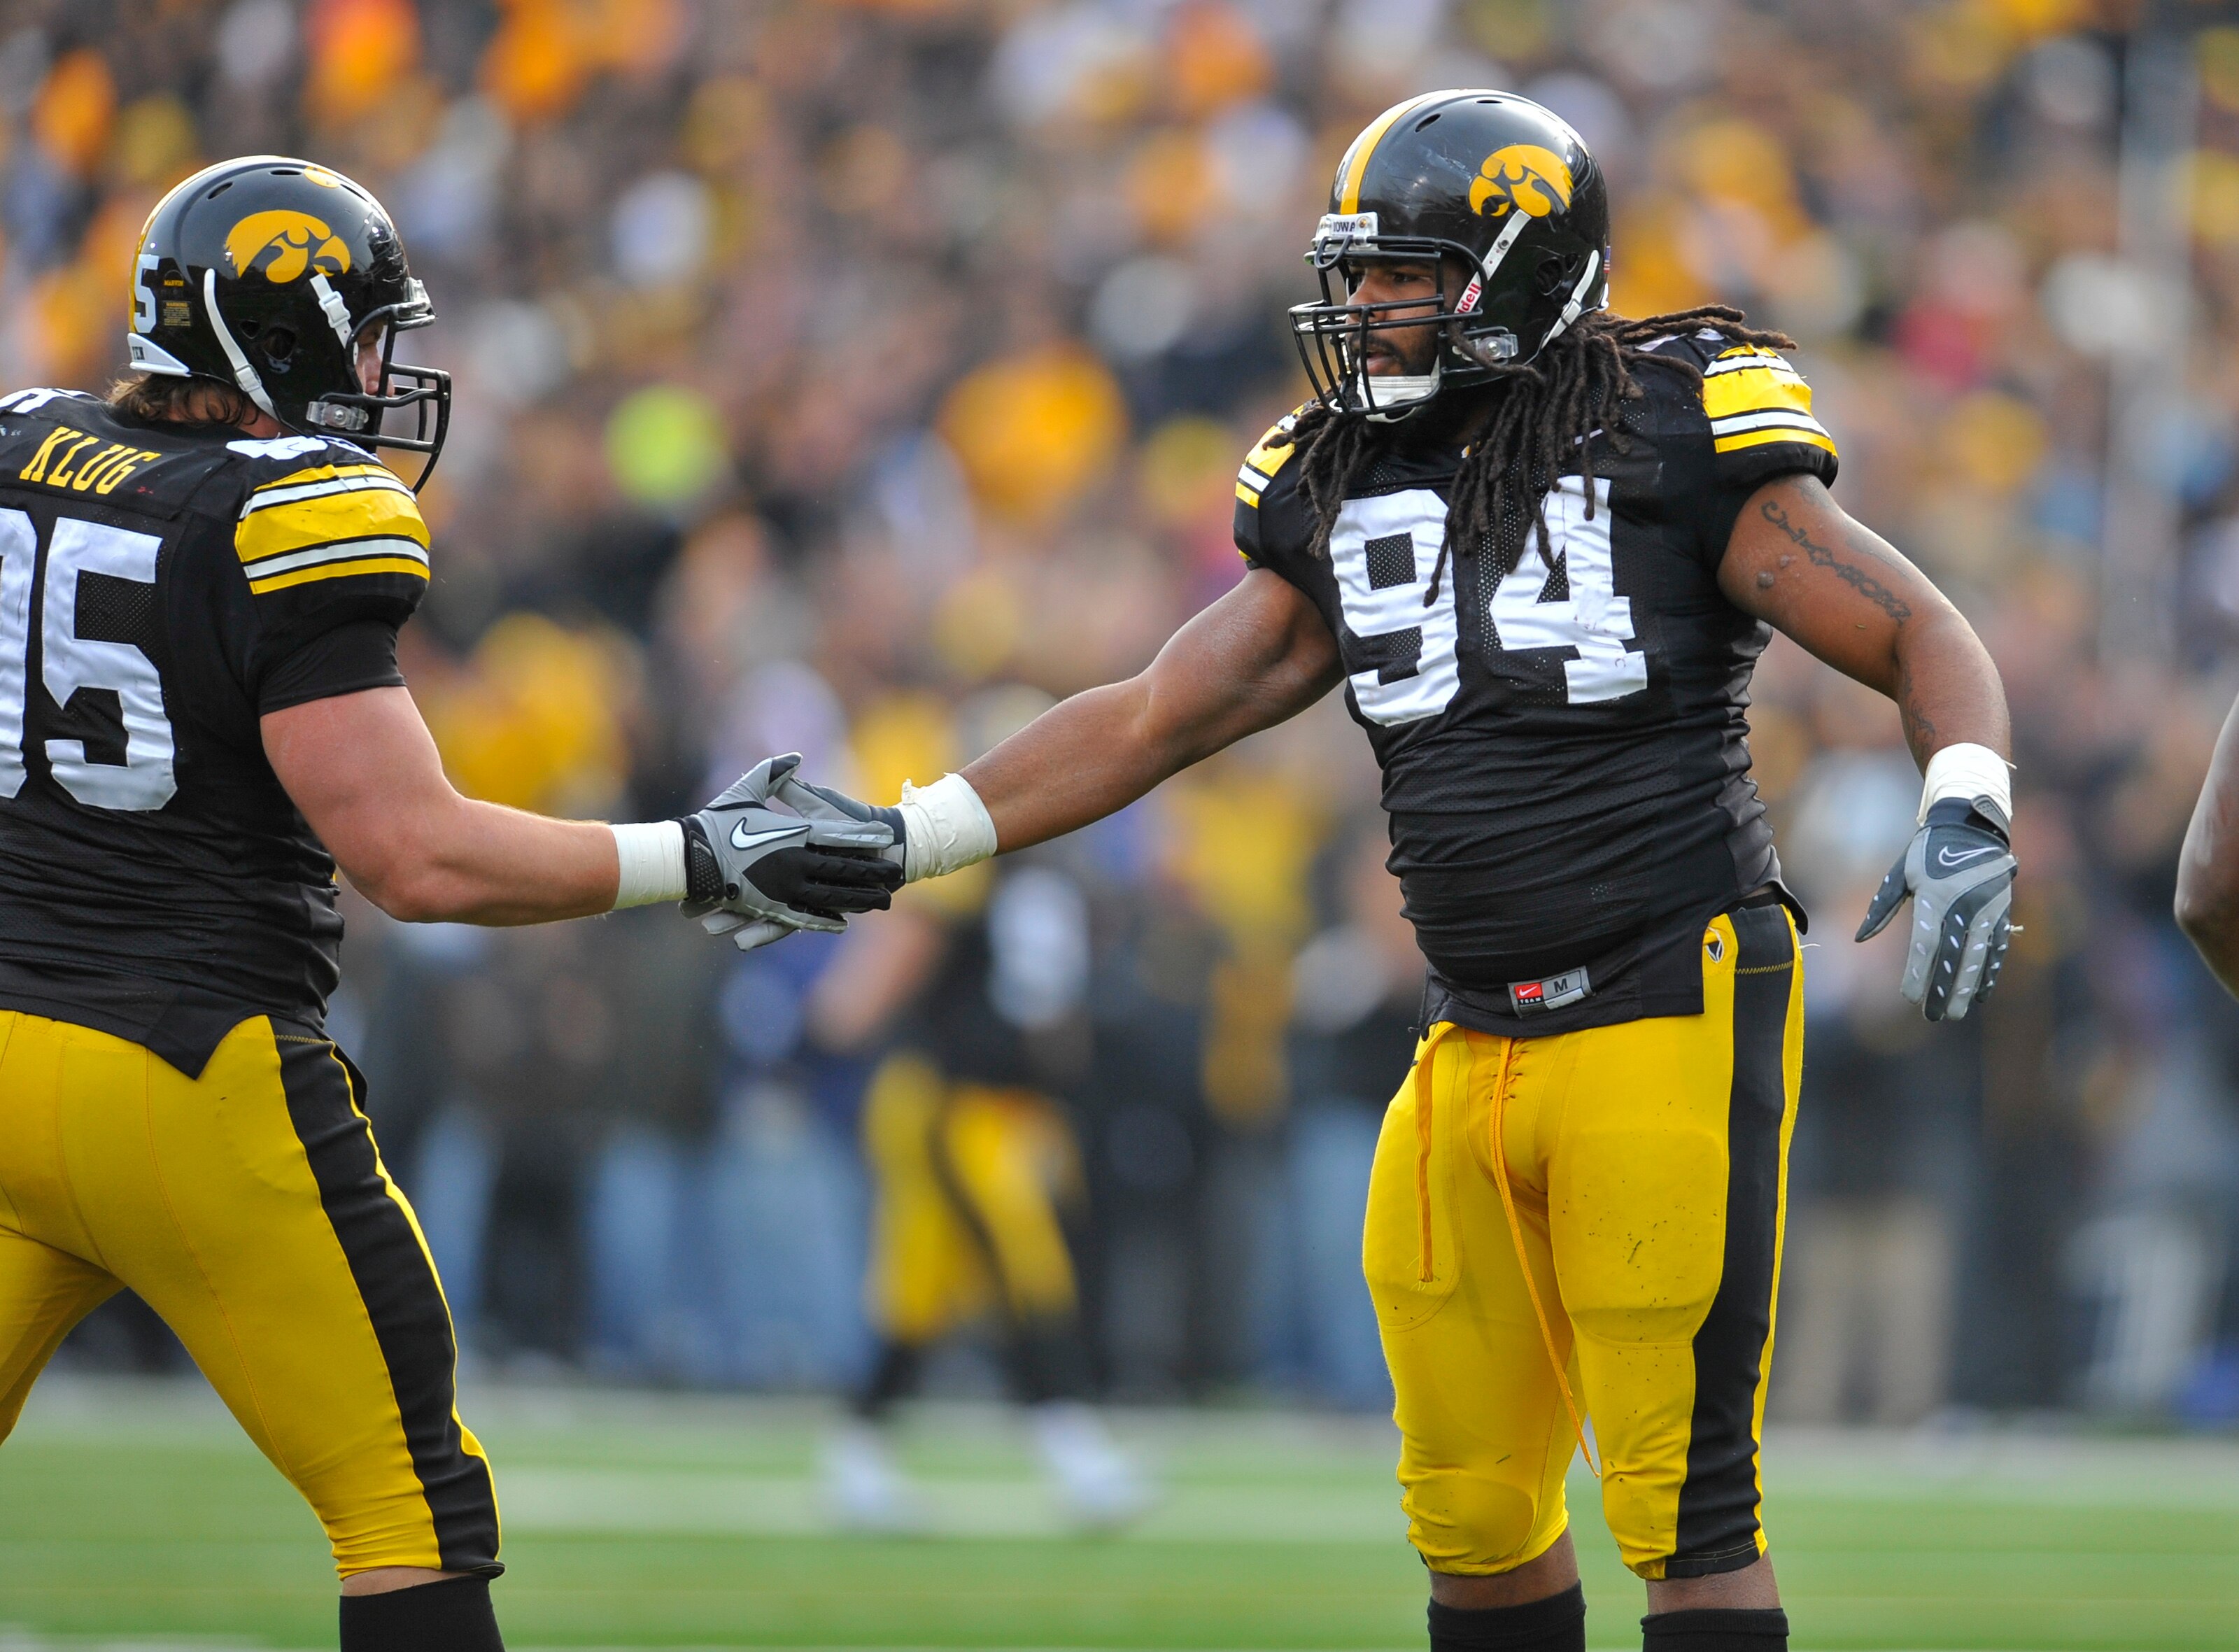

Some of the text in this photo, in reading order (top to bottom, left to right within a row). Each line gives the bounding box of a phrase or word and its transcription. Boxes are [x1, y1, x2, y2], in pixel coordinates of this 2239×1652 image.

[1332, 221, 1356, 232] IOWA
[134, 254, 160, 333] 5
[19, 425, 162, 495] KLUG
[1329, 475, 1648, 728] 94
[0, 507, 178, 811] 5
[1553, 978, 1569, 993] M
